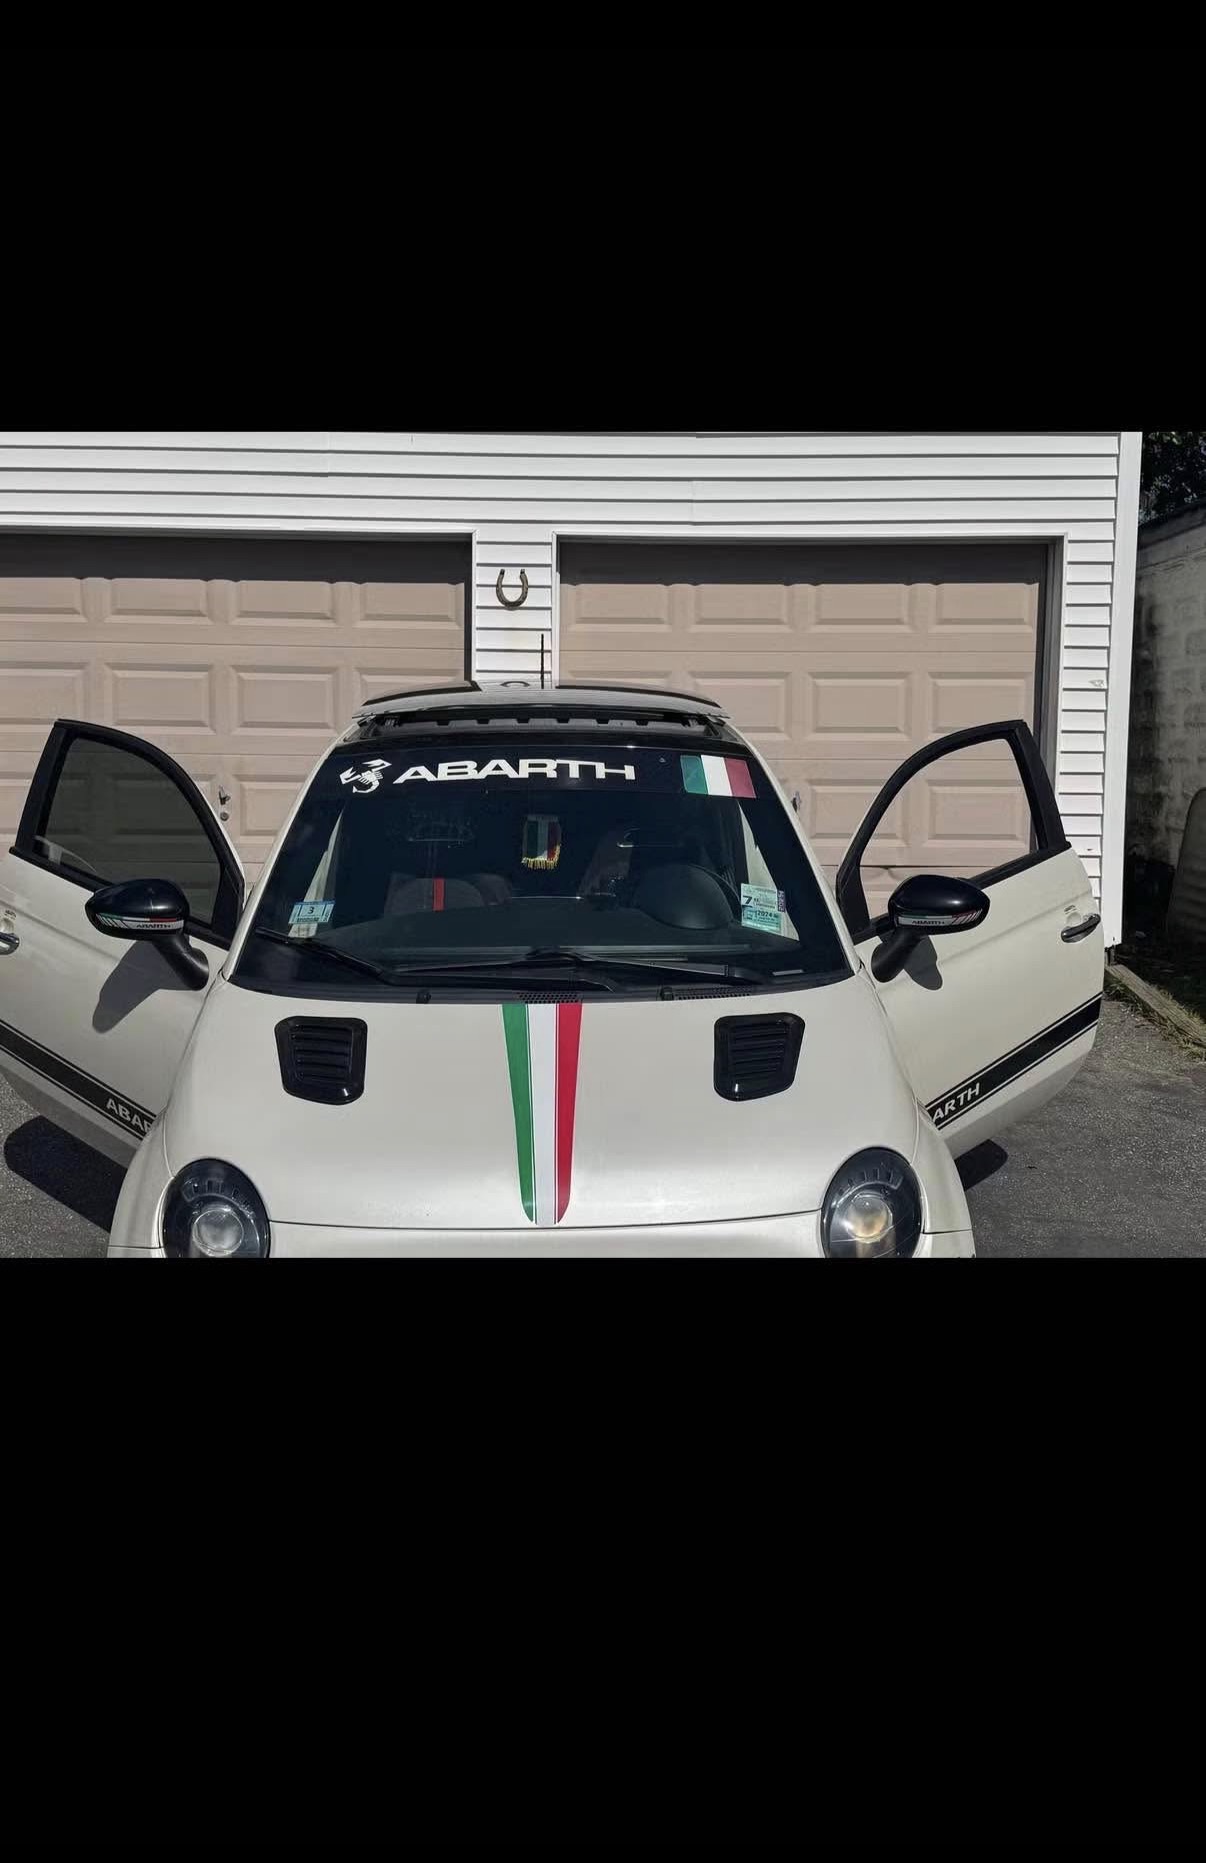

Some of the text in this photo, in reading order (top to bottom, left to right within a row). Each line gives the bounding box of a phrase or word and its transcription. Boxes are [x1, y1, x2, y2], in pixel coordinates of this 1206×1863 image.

[393, 758, 636, 784] ABARTH
[743, 895, 753, 905] 7
[308, 906, 315, 915] 3
[932, 1082, 980, 1123] ARTH
